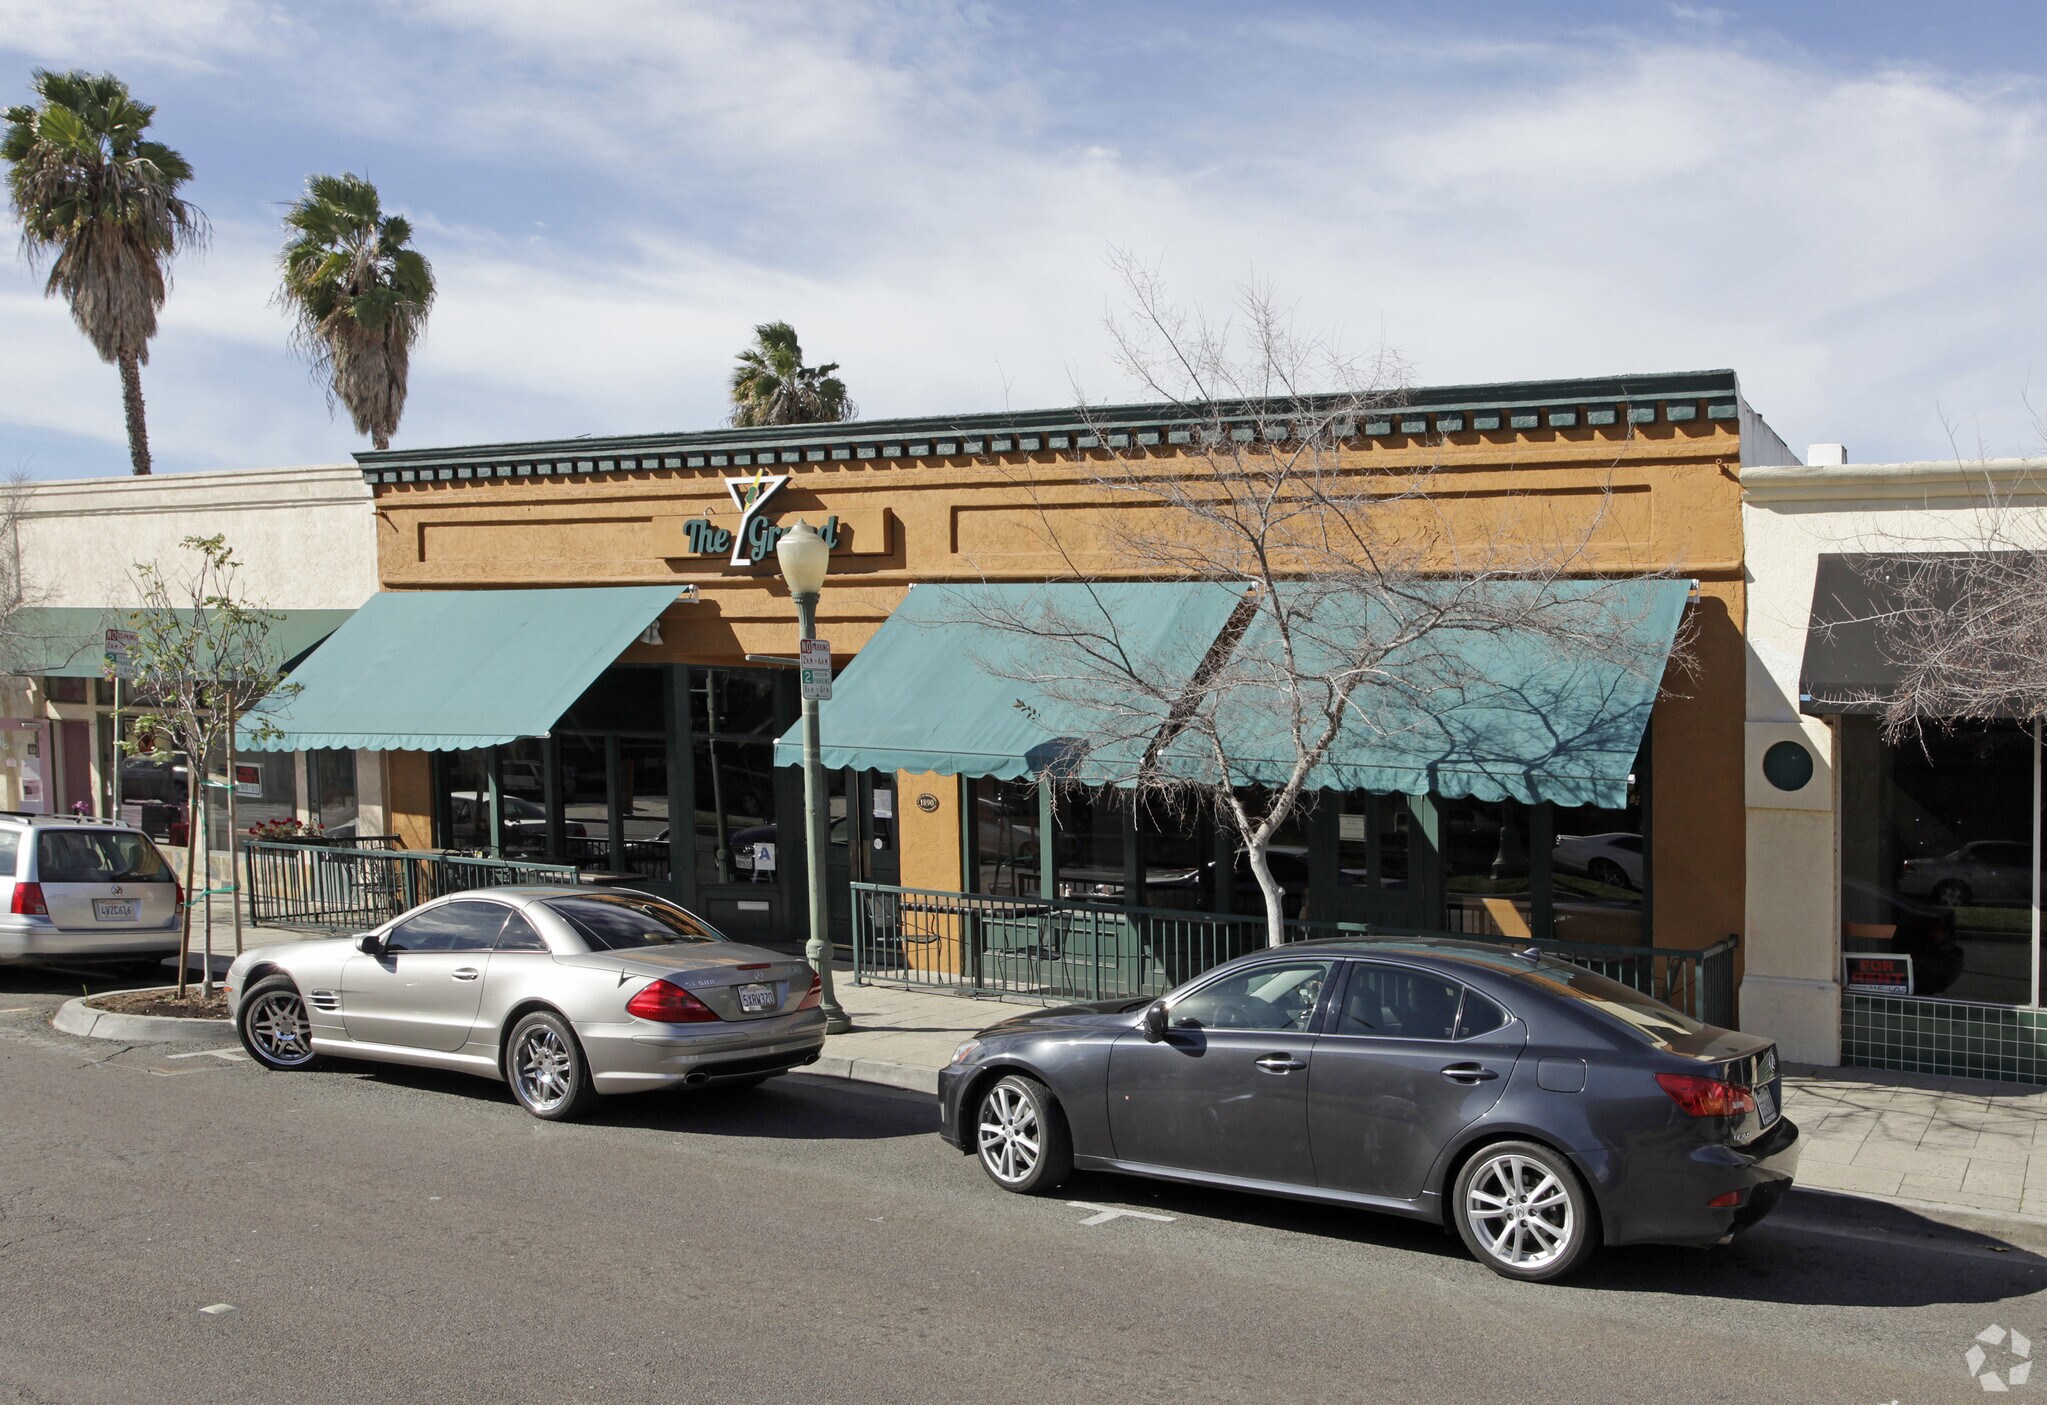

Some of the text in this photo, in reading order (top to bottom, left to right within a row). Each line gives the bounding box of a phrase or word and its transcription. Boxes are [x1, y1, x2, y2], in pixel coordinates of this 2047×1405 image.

[684, 516, 838, 561] The Grd
[801, 641, 829, 652] NO PARKING
[804, 671, 811, 683] 2
[759, 847, 771, 860] A
[1860, 960, 1895, 972] FOR
[1851, 973, 1905, 985] RENT
[743, 993, 774, 1007] 5XRW320
